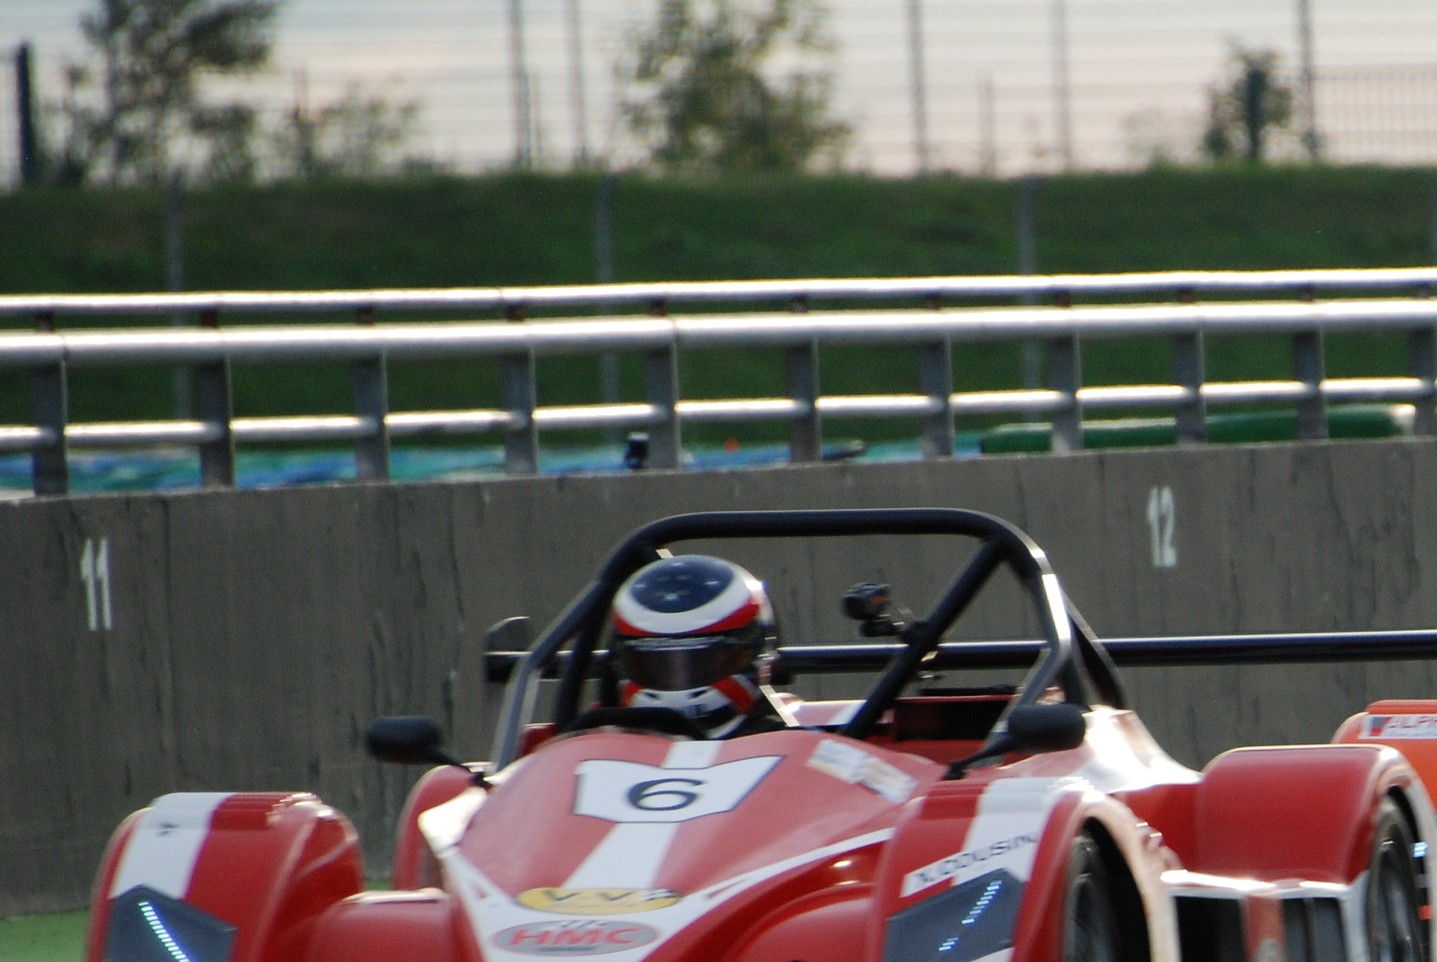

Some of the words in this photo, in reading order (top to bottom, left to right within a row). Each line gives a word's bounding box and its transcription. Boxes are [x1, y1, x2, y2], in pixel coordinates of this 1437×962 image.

[1147, 486, 1177, 567] 12
[81, 538, 112, 631] 11
[627, 777, 706, 811] 6
[508, 927, 641, 945] HMC
